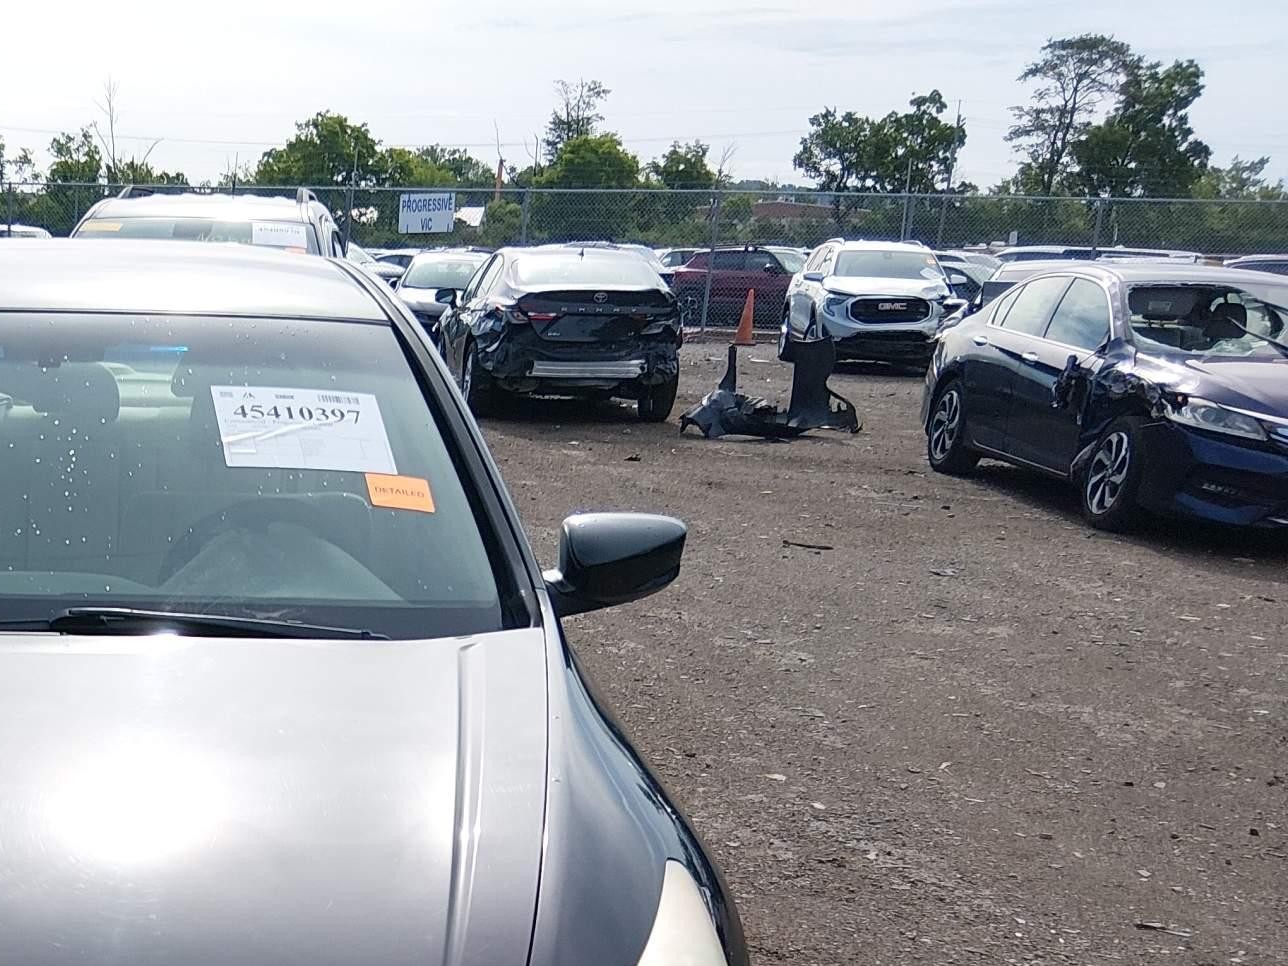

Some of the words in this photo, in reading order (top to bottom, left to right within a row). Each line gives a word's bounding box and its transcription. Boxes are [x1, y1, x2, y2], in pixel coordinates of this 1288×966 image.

[402, 198, 453, 213] PROGRESSIVE
[421, 217, 433, 231] VIC
[878, 302, 908, 311] GMC
[233, 404, 361, 425] 45410397
[374, 485, 426, 499] DETAILED
